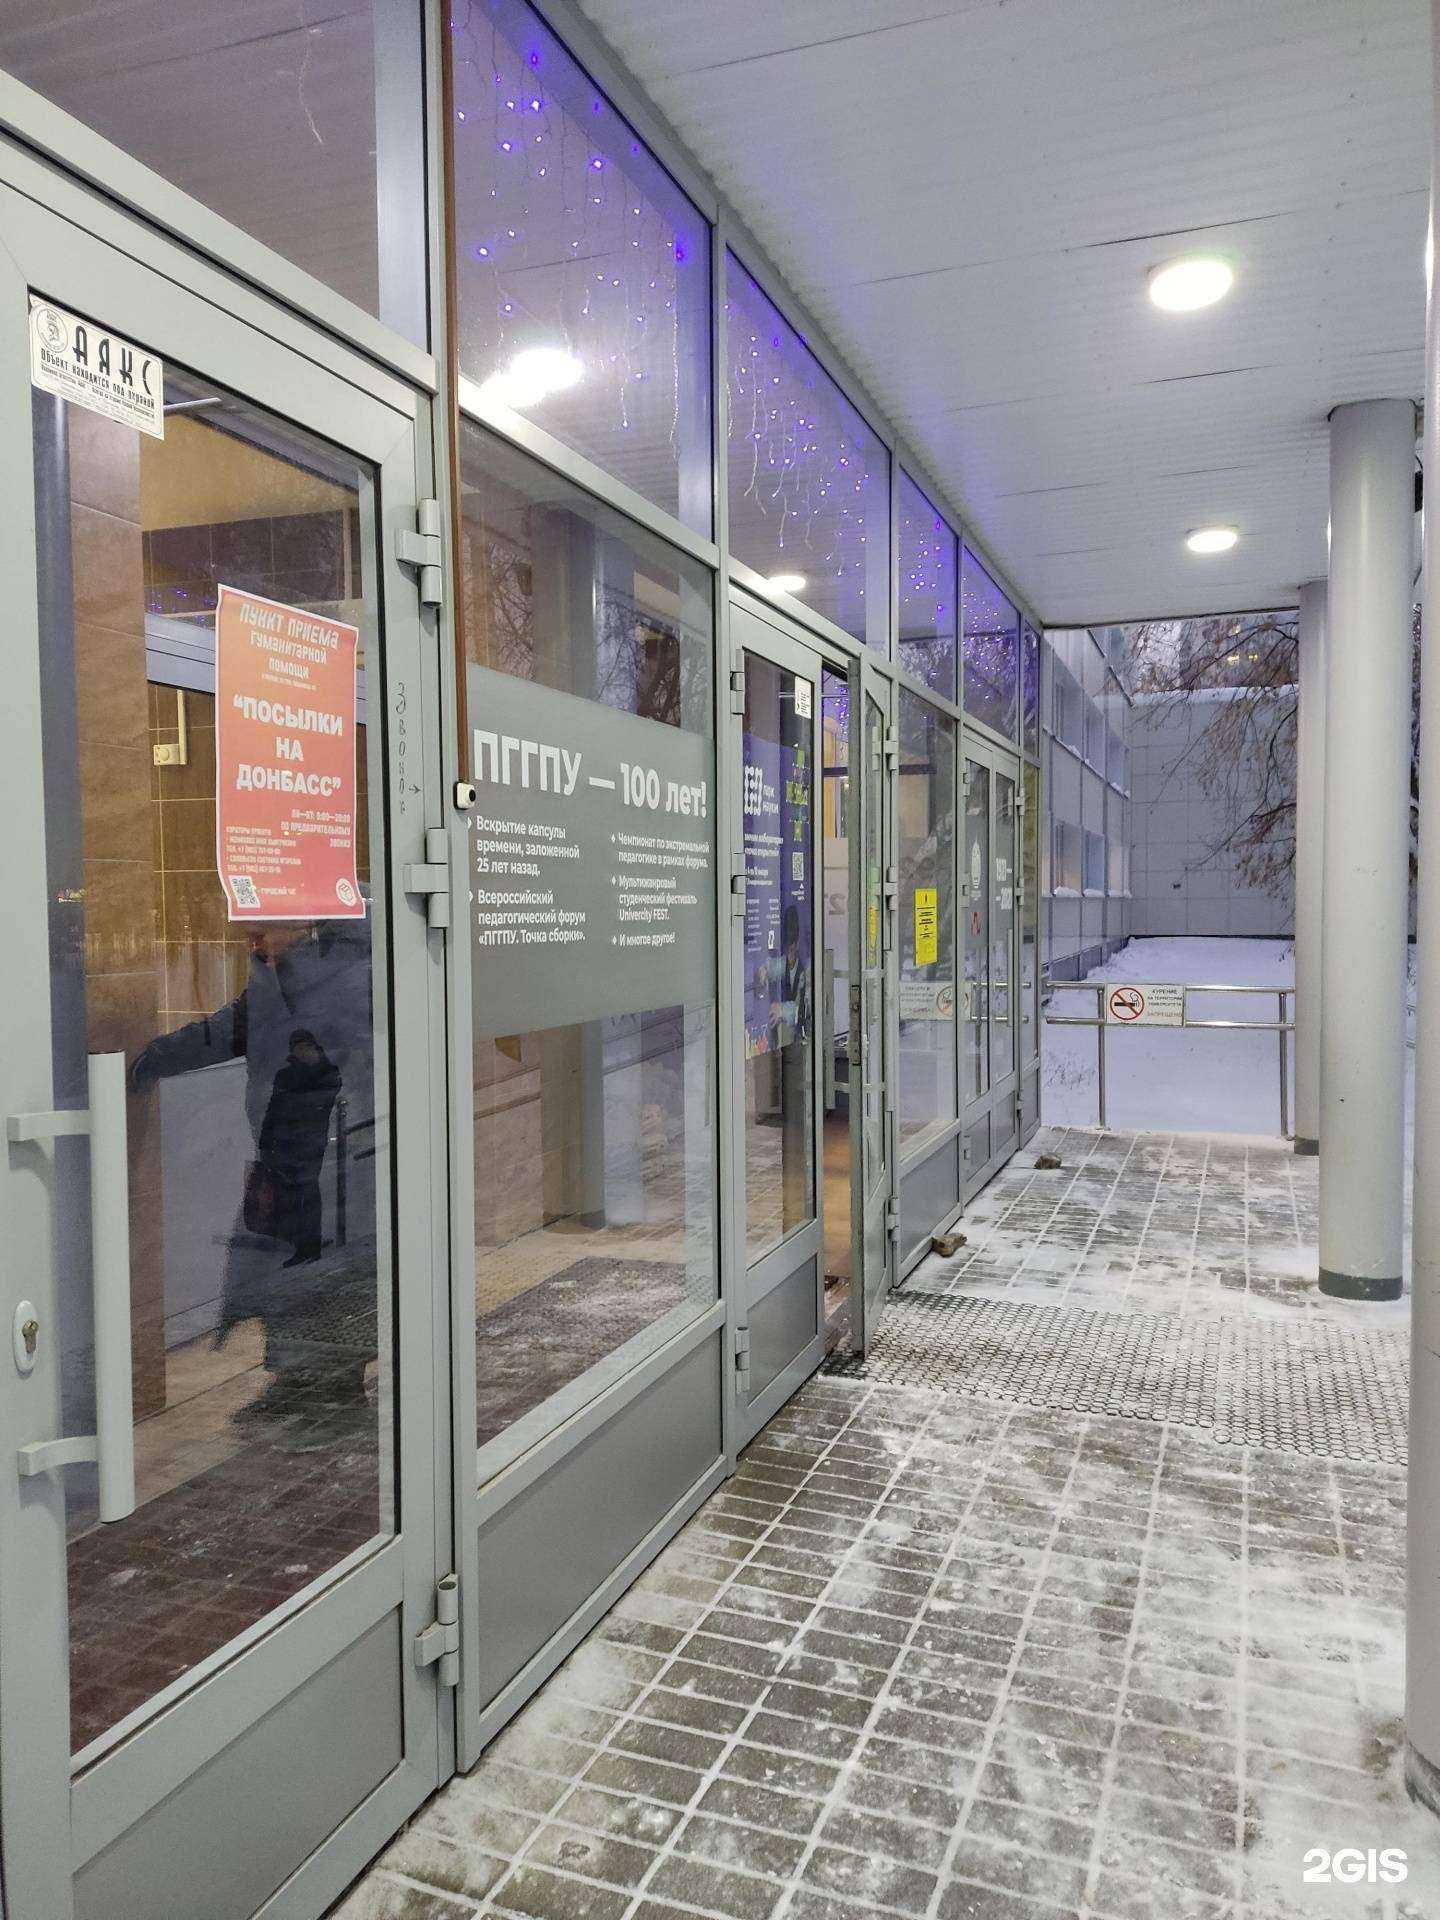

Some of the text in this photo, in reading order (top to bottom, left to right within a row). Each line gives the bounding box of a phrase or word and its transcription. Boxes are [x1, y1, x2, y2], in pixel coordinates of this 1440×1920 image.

[73, 325, 152, 396] АЯКС
[239, 603, 284, 633] ПУНКТ
[249, 630, 327, 665] ГУМАНИТАРНОЙ
[268, 657, 310, 679] ПОМОЩИ
[275, 736, 304, 761] НА
[473, 728, 583, 796] ПГГПУ
[619, 762, 661, 810] 100
[665, 781, 707, 819] лет!
[476, 815, 567, 840] Вскрытие капсулы
[476, 840, 580, 859] времени, заложенной
[618, 832, 710, 853] Чемпионат по экстремальной
[476, 858, 490, 873] 25
[491, 862, 508, 874] лет
[618, 851, 657, 865] педагогике
[658, 855, 663, 865] в
[663, 855, 685, 868] рамках
[618, 875, 677, 890] Мультижанровый
[478, 889, 554, 907] Всероссийский
[618, 892, 698, 908] студенческий фестиваль
[478, 909, 586, 927] педагогический форум
[619, 907, 653, 923] Univercity
[520, 929, 547, 943] Точка
[619, 932, 676, 947] И многое другое!
